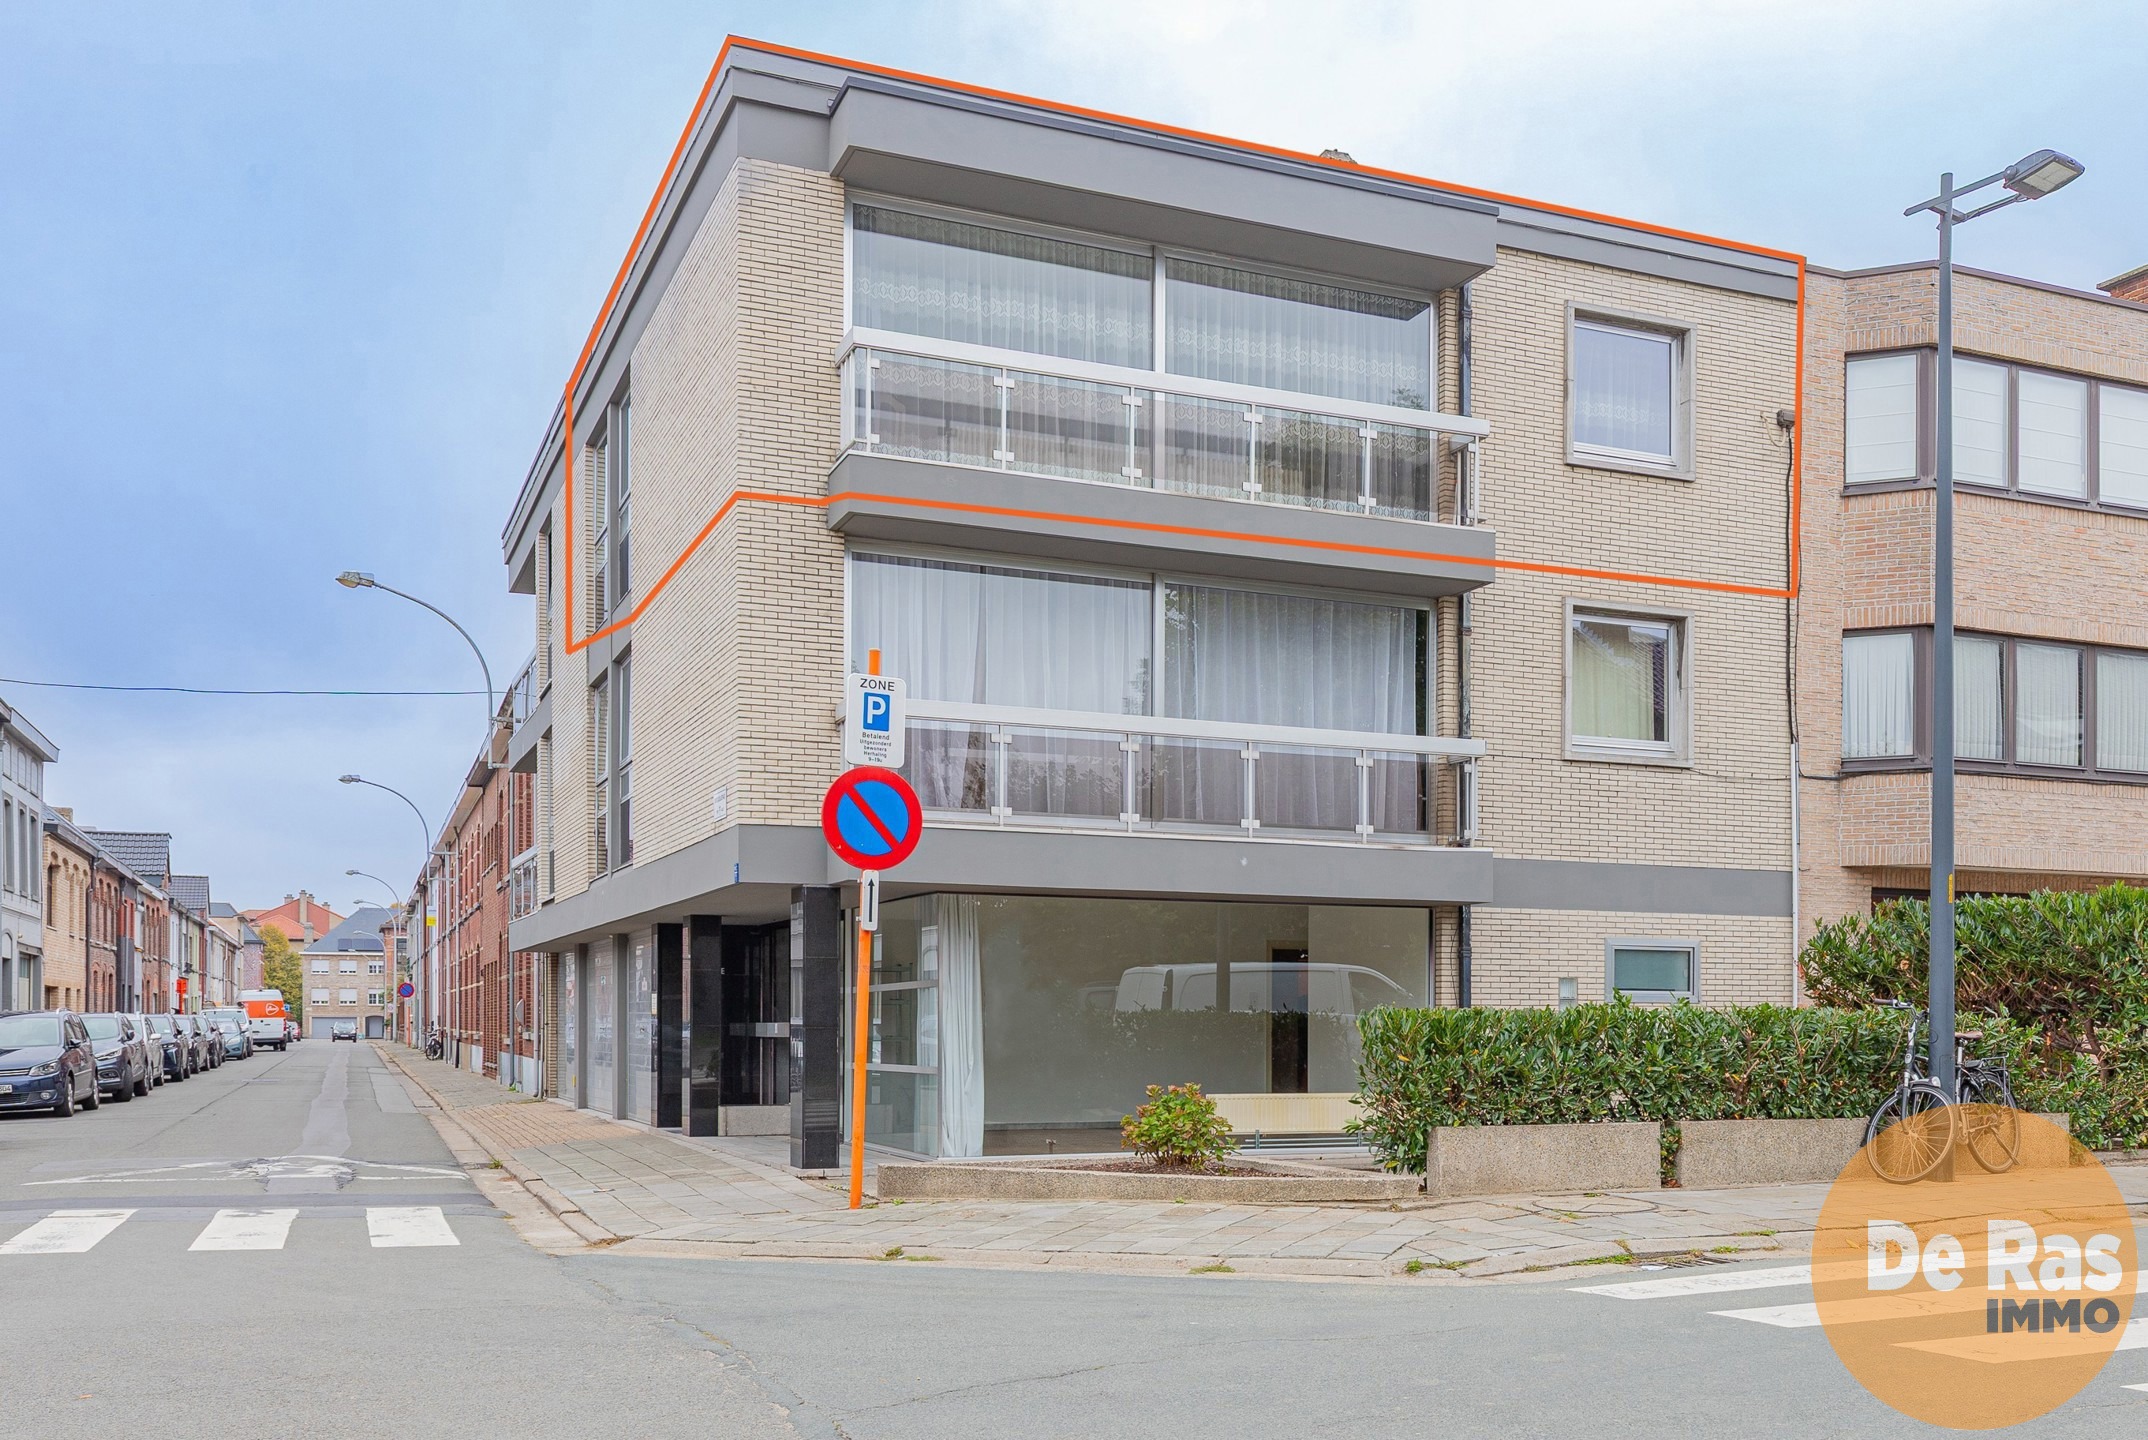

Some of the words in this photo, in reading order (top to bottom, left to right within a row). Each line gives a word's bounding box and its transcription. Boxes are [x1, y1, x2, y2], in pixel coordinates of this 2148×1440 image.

[860, 678, 895, 691] ZONE
[867, 695, 886, 724] P
[862, 731, 890, 740] Betalend
[859, 739, 892, 747] Uitgezonderd
